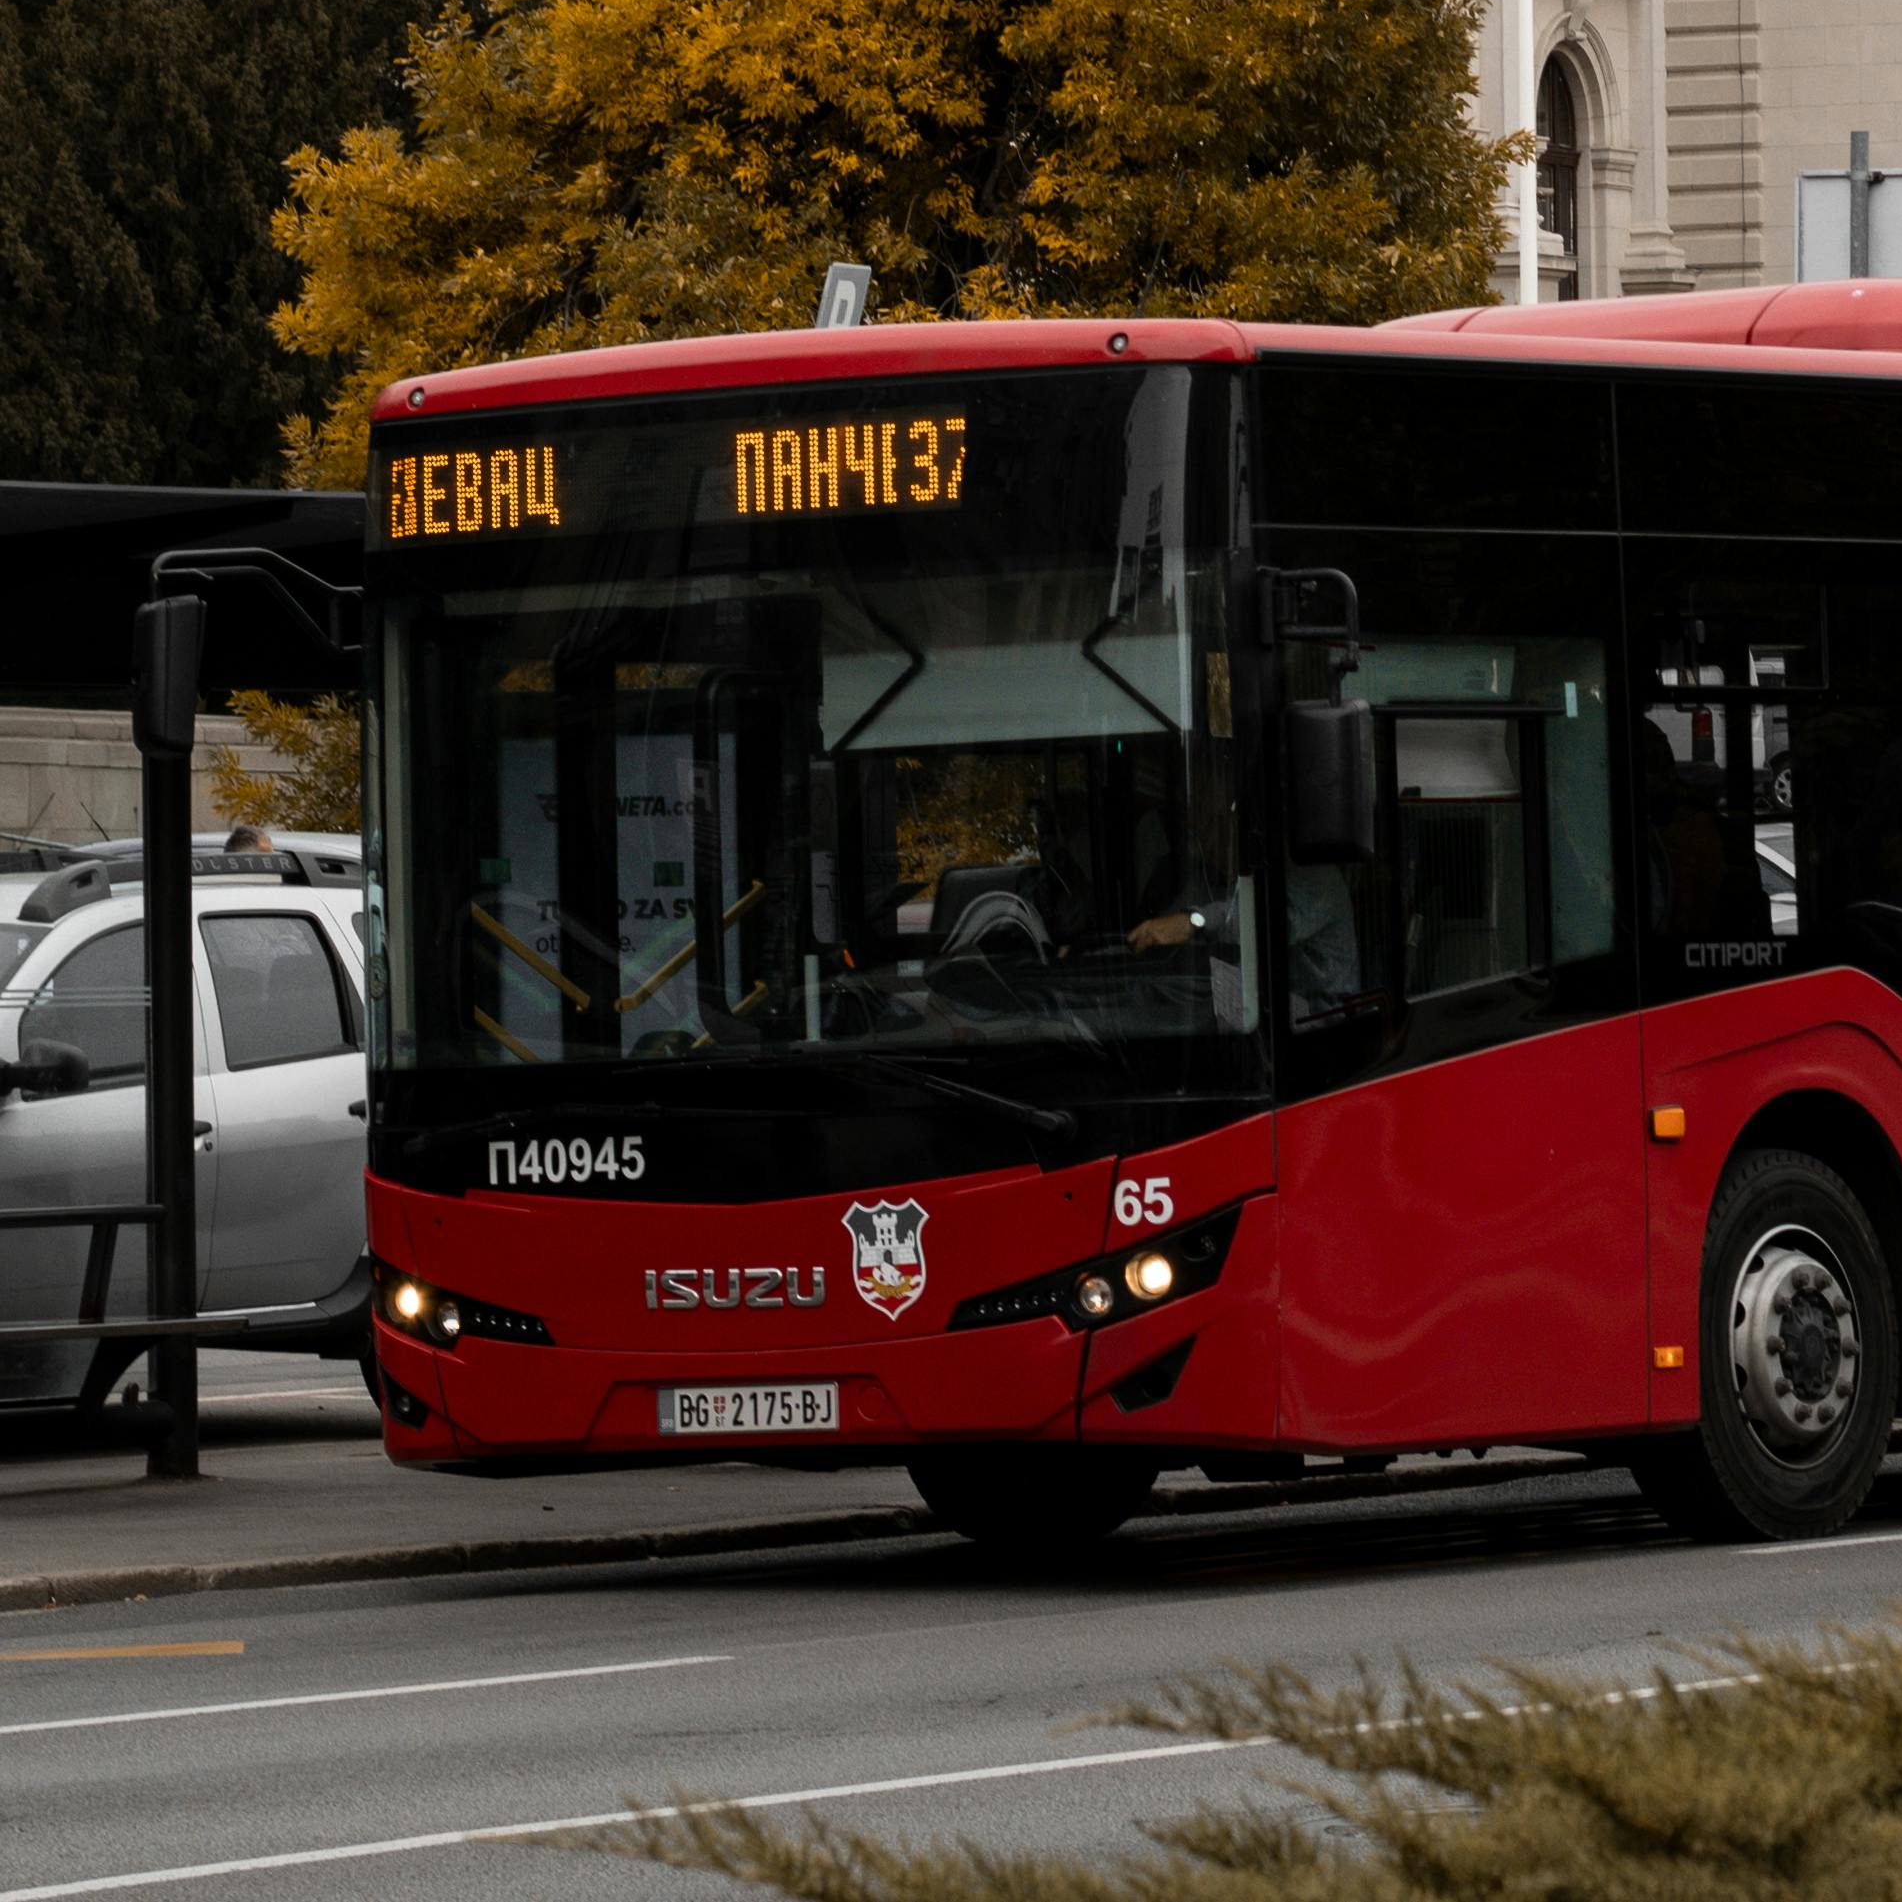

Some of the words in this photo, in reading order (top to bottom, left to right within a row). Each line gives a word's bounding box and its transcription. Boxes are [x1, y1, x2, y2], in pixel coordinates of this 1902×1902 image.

[1685, 940, 1787, 968] CITIPORT
[488, 1135, 646, 1186] П40945
[1114, 1176, 1174, 1227] 65
[644, 1266, 826, 1310] ISUZU
